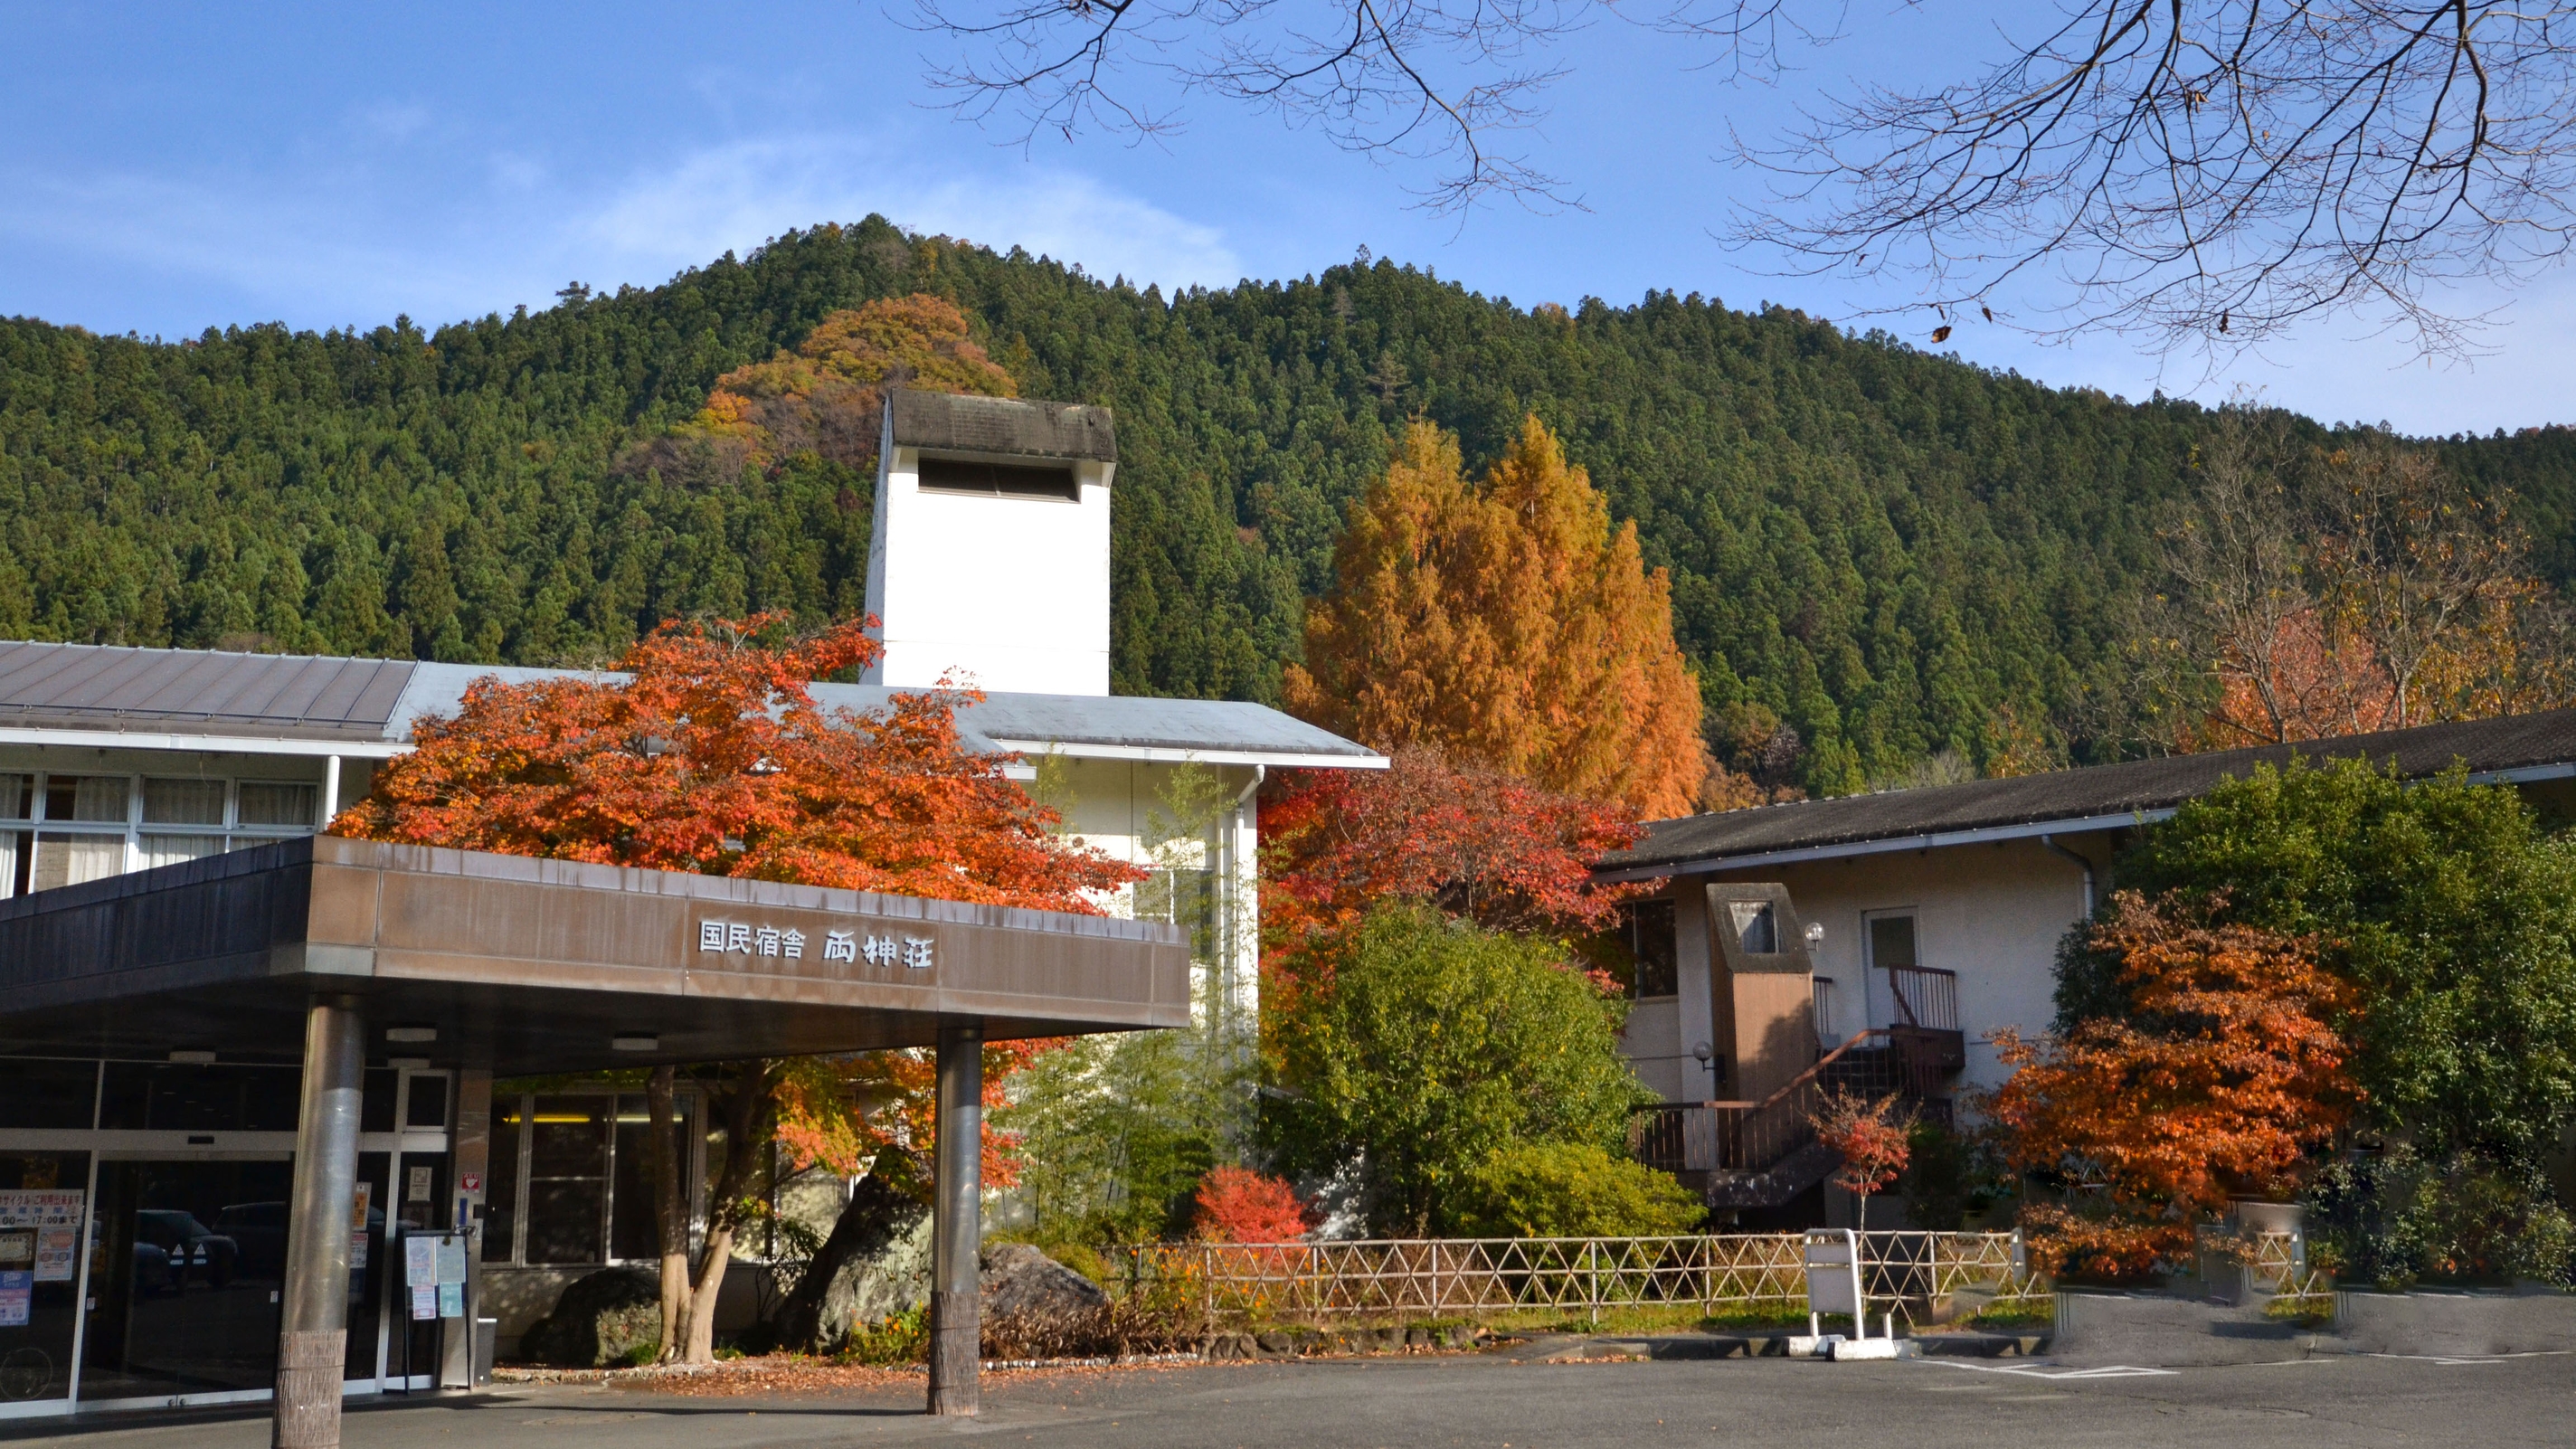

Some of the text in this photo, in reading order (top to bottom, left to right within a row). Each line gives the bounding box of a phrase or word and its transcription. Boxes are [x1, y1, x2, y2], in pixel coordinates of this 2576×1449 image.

[700, 921, 934, 968] 国民宿舎 両神荘
[0, 1195, 30, 1207] サイクル
